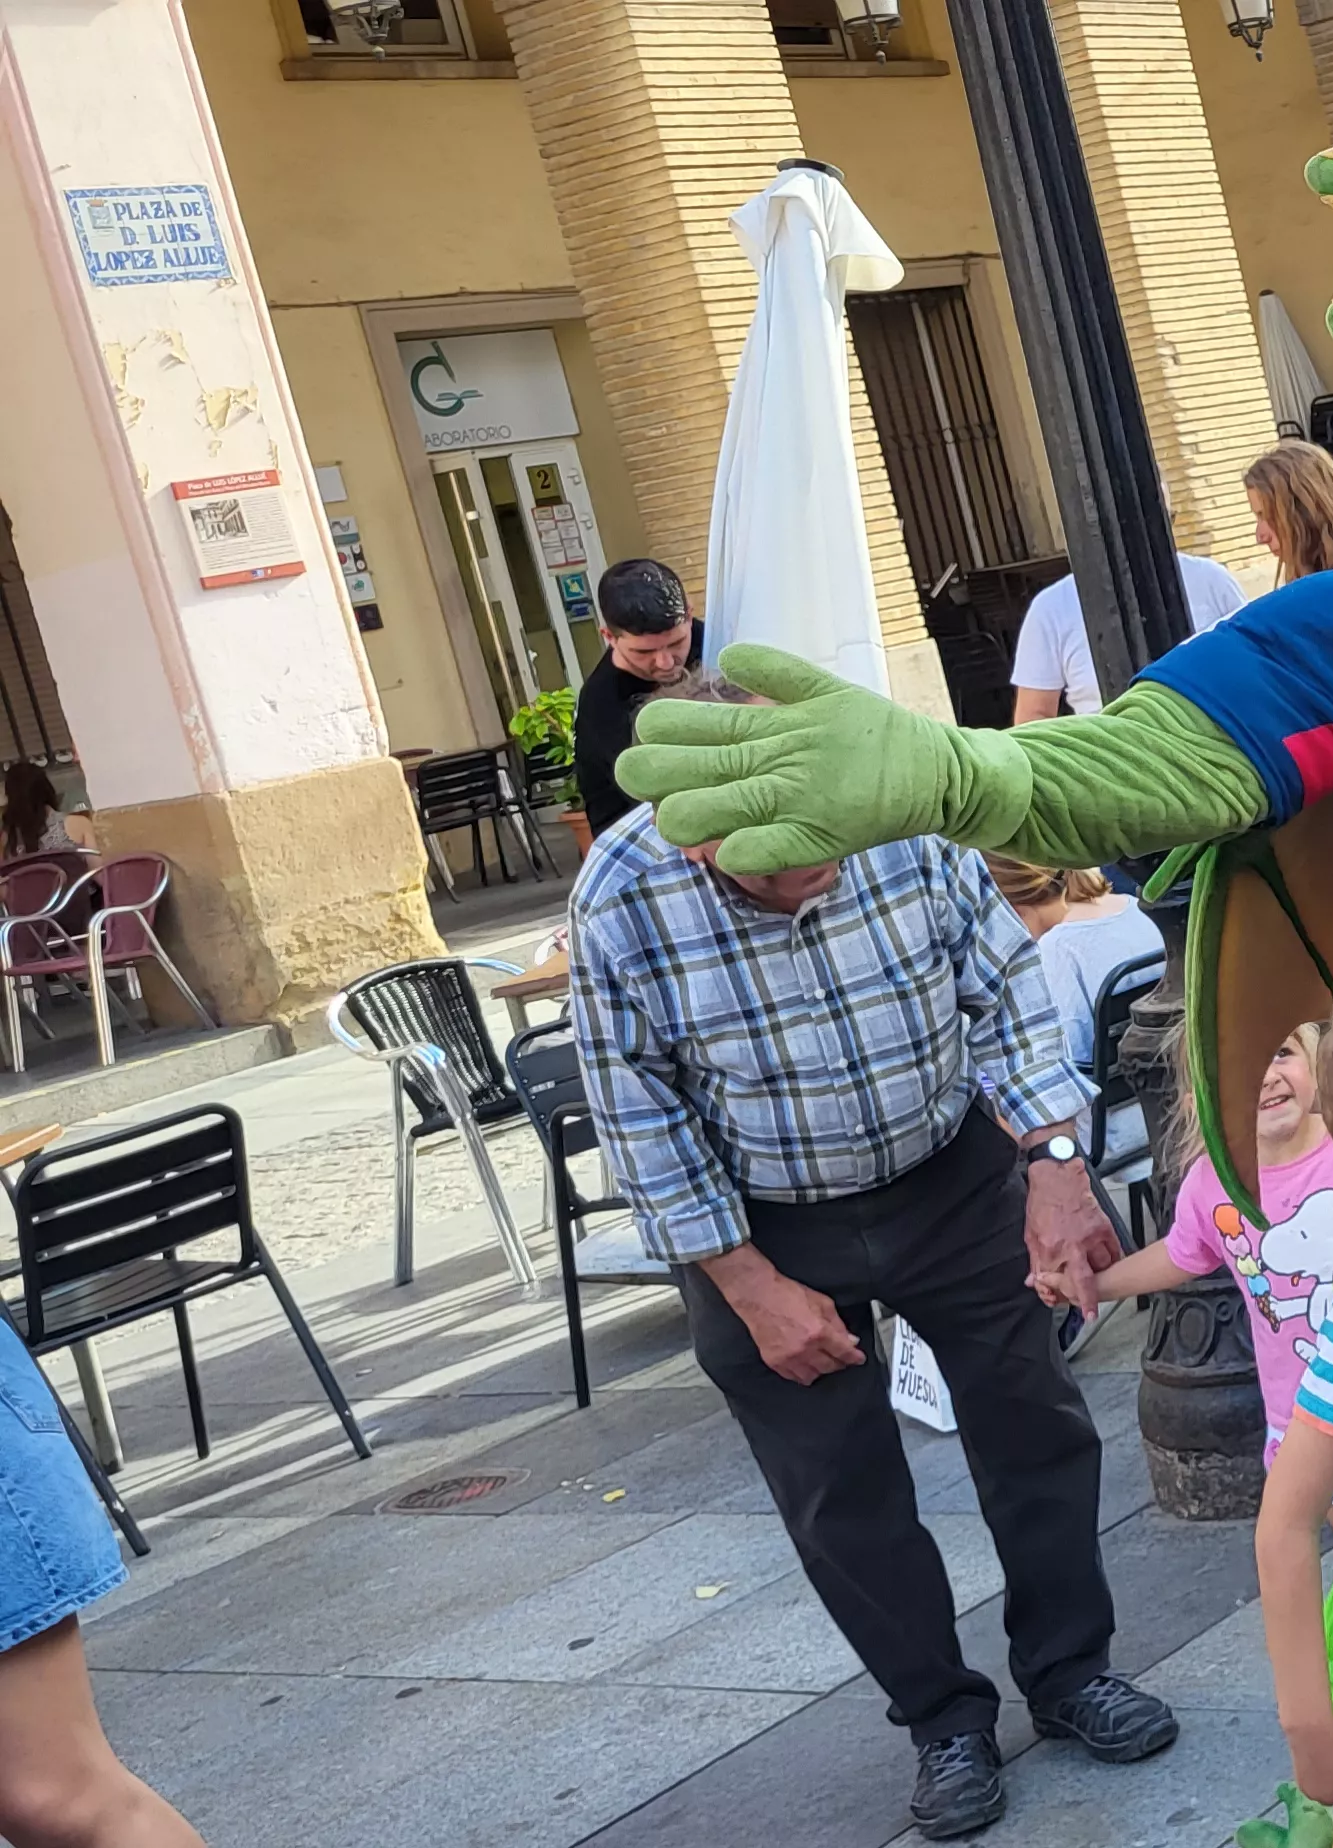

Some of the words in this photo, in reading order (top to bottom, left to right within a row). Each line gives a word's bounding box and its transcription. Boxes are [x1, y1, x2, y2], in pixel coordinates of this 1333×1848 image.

[112, 200, 178, 222] PLAZA
[180, 201, 203, 218] DE
[119, 226, 140, 246] D.
[147, 223, 201, 245] LUIS
[92, 249, 158, 272] LOPEZ
[163, 246, 221, 269] ALLUE
[536, 469, 551, 490] 2
[899, 1341, 916, 1370] DE
